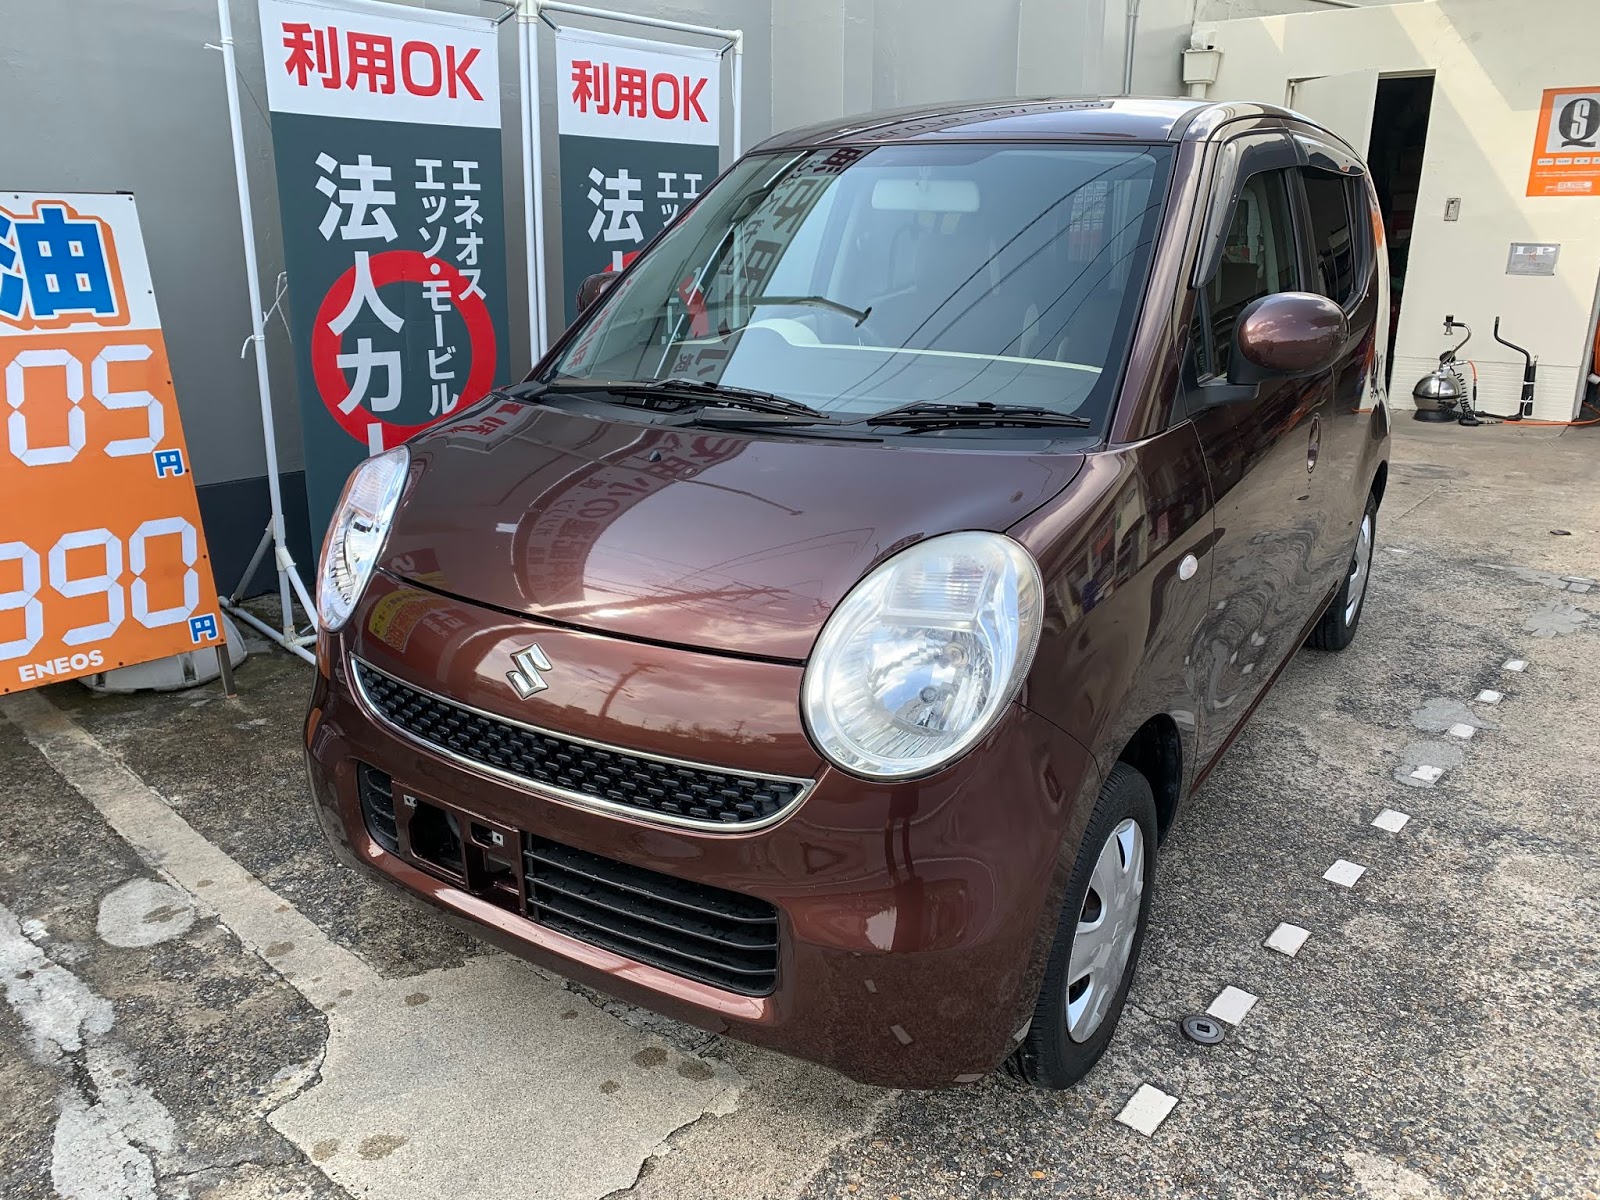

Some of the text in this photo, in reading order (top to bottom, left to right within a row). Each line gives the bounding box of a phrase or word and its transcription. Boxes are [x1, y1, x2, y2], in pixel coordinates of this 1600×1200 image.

[281, 22, 485, 102] 利用OK
[571, 59, 709, 123] 利用OK
[452, 159, 487, 301] エネオス
[0, 208, 116, 317] 油
[154, 449, 184, 478] 円
[190, 614, 218, 643] 円
[18, 649, 104, 682] ENEOS
